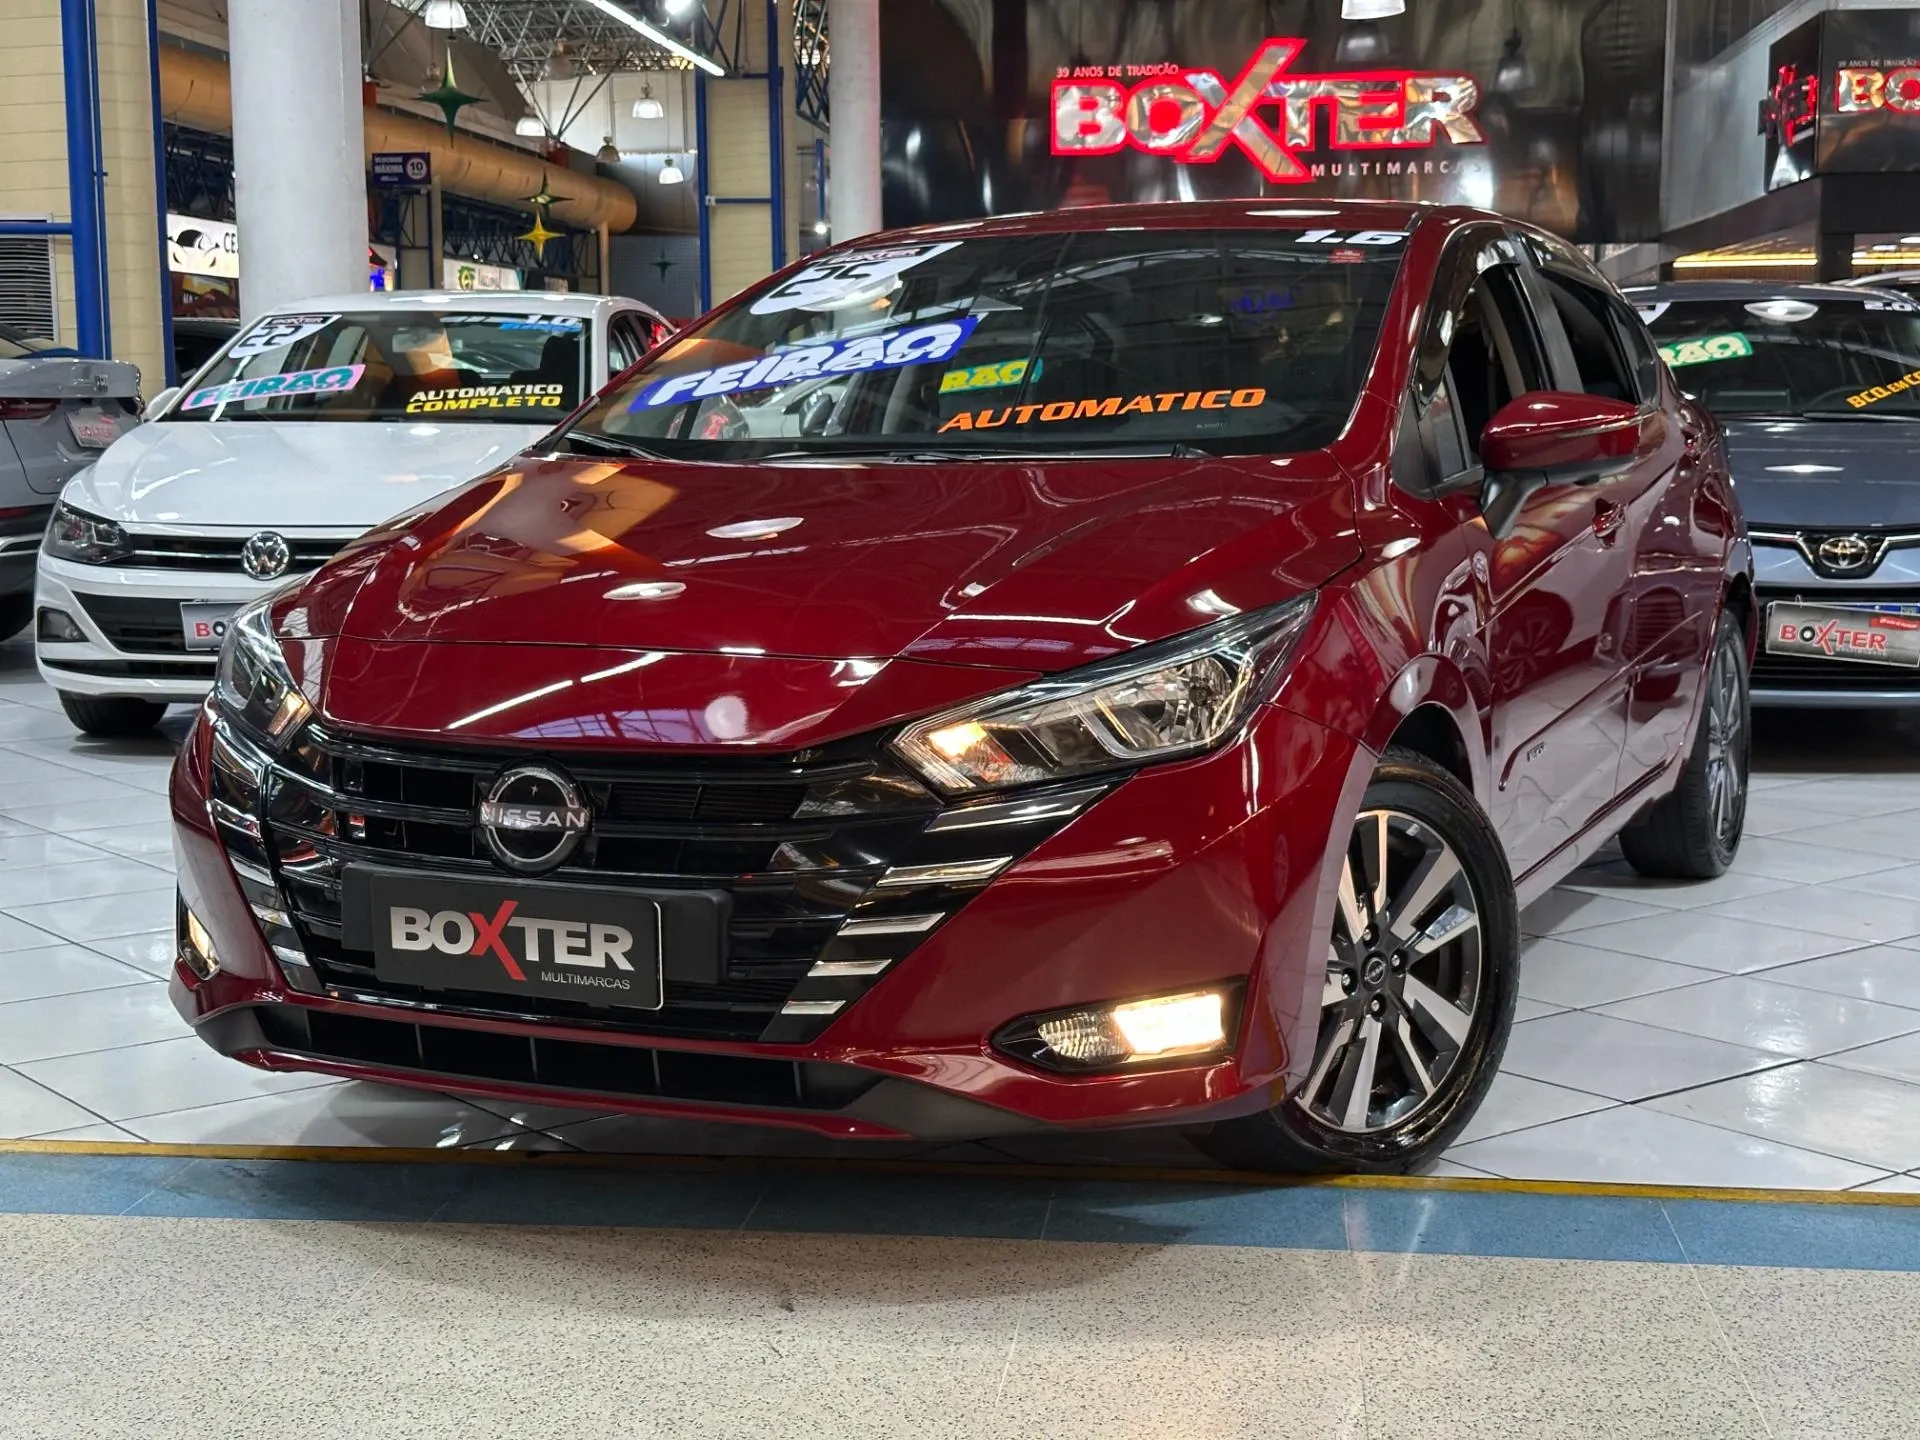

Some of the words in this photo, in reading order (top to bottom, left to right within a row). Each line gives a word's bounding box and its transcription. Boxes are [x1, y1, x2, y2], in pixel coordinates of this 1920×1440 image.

[1056, 67, 1069, 78] 39
[1073, 66, 1104, 77] ANOS
[1108, 65, 1122, 76] DE
[1126, 62, 1179, 77] TRADIÇÃO
[1051, 37, 1488, 183] BOXTER
[410, 161, 423, 171] 10
[1311, 161, 1483, 177] MULTIMARCAS
[1295, 229, 1410, 245] 1.6
[1863, 299, 1913, 312] 2.0
[406, 395, 562, 413] COMPLETO
[1779, 619, 1887, 656] BOXTER
[481, 801, 586, 828] NISSAN
[389, 899, 636, 981] BOXTER
[541, 970, 632, 990] MULTIMARCAS
